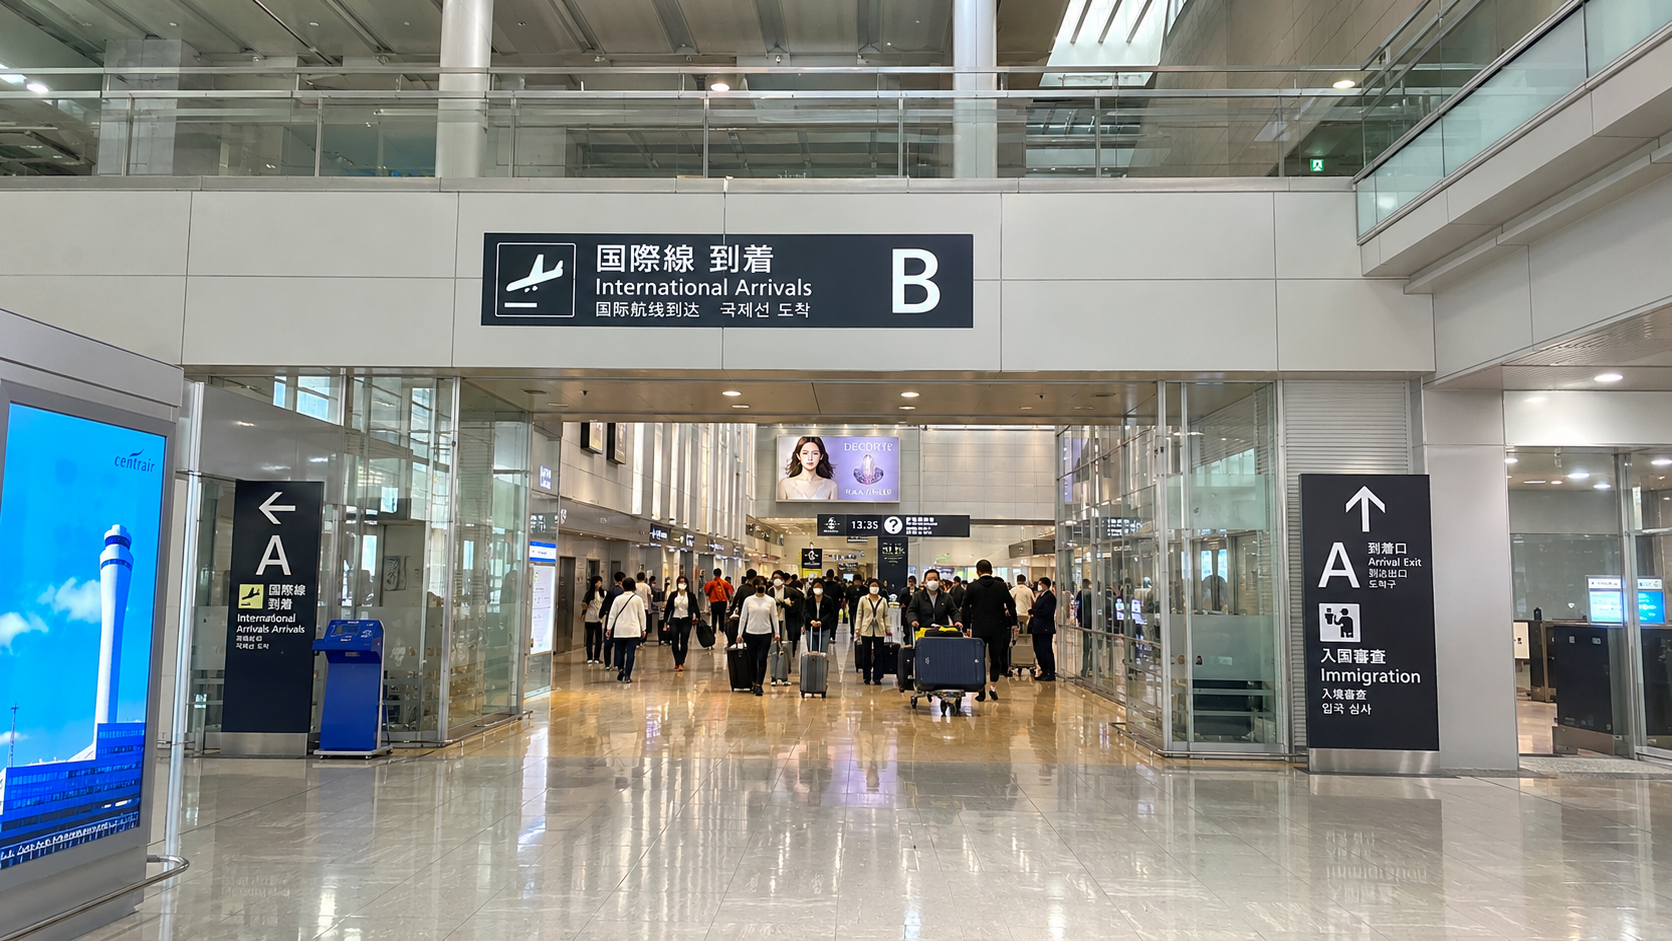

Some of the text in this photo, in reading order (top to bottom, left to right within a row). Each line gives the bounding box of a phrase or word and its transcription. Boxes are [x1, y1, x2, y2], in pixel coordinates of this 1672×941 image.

[596, 243, 774, 274] 国際線 到着
[596, 277, 812, 296] International Arrivals
[891, 248, 942, 314] B
[595, 301, 700, 318] 国际航线到达
[720, 301, 811, 318] 국제선 도착
[114, 455, 156, 472] centrair
[255, 534, 293, 576] A
[1367, 541, 1407, 555] 到着口
[1317, 541, 1361, 589] A
[1367, 556, 1422, 567] Arrival Exit
[236, 624, 306, 634] Arrivals Arrivals
[1321, 667, 1421, 687] Immigration
[1321, 702, 1373, 716] 입국 심사
